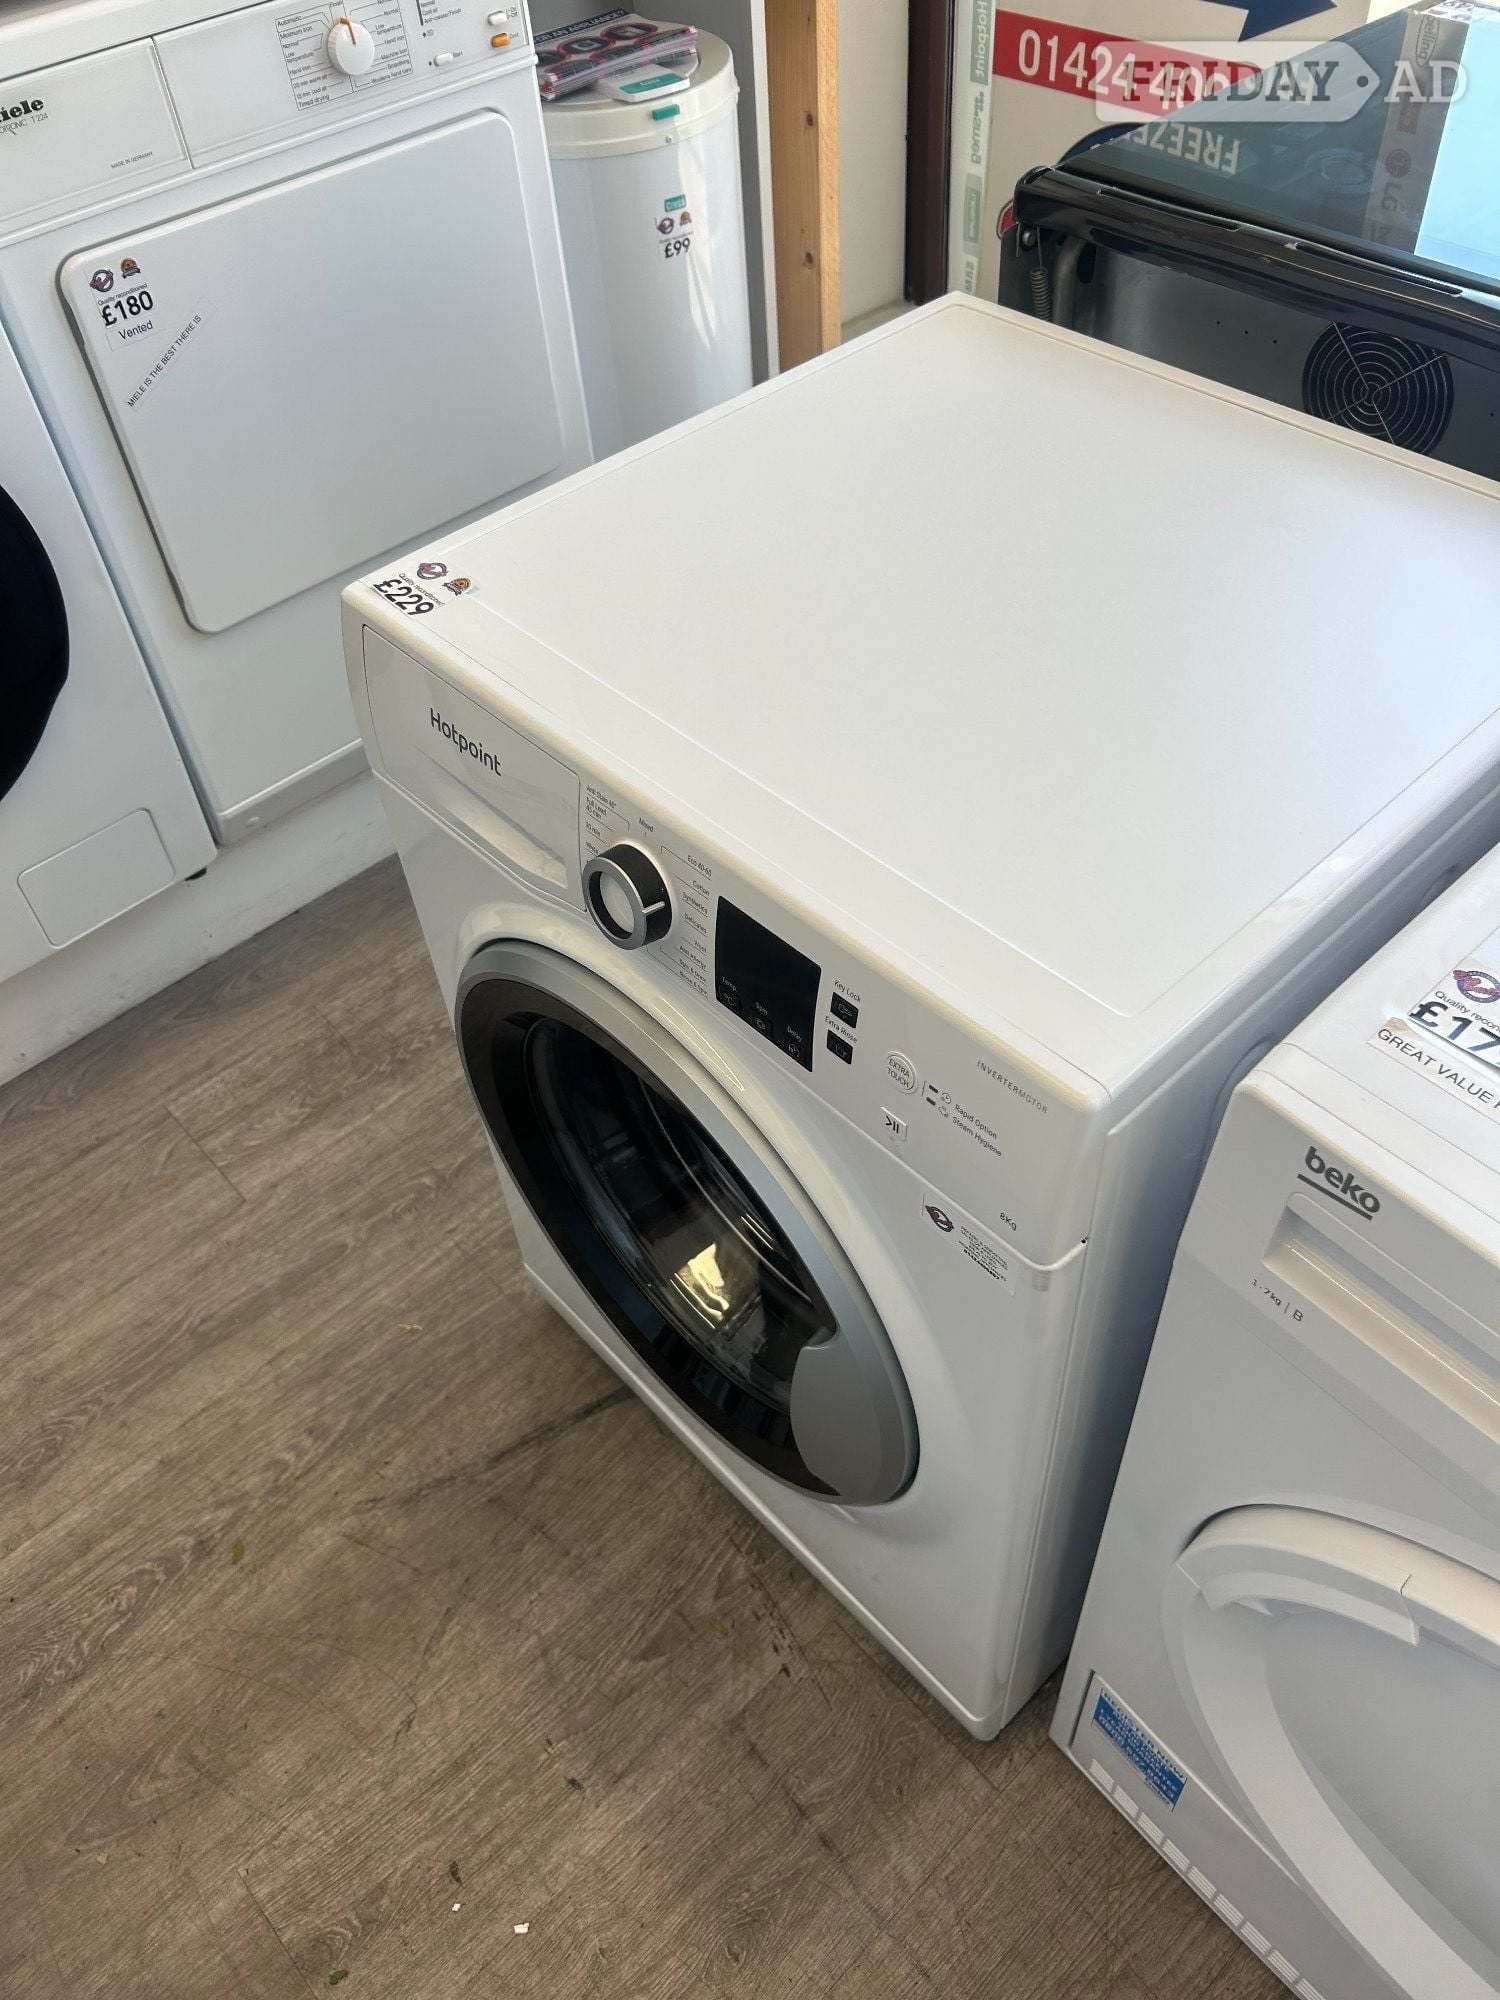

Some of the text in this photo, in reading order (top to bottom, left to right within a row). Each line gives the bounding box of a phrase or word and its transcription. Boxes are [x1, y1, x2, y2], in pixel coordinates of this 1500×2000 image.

[277, 16, 302, 27] Automatic
[1019, 29, 1137, 100] 01424
[0, 99, 44, 122] iele
[298, 94, 330, 108] Timed drying
[131, 151, 153, 164] GERMANY
[664, 237, 691, 259] £99
[97, 283, 148, 306] Quality reconditioned
[102, 290, 154, 327] £180
[118, 320, 154, 340] Vented
[127, 314, 202, 408] MIELE IS THE BEST THERE IS
[372, 579, 434, 616] £229
[430, 707, 502, 777] Hotpoint
[687, 854, 698, 867] Eco
[692, 880, 710, 896] Cotton
[834, 979, 861, 1003] Key Lock
[1434, 990, 1471, 1014] Quality
[825, 1016, 858, 1044] Extra Rinse
[1409, 1001, 1500, 1066] £17
[887, 1067, 909, 1088] TOUCH
[889, 1058, 910, 1078] EXTRA
[1378, 1028, 1495, 1104] GREAT VALUE
[976, 1060, 1048, 1114] INVERTERMOTOR
[955, 1104, 998, 1140] Rapid Option
[952, 1116, 1002, 1157] Steam Hygiene
[1304, 1145, 1381, 1215] beko
